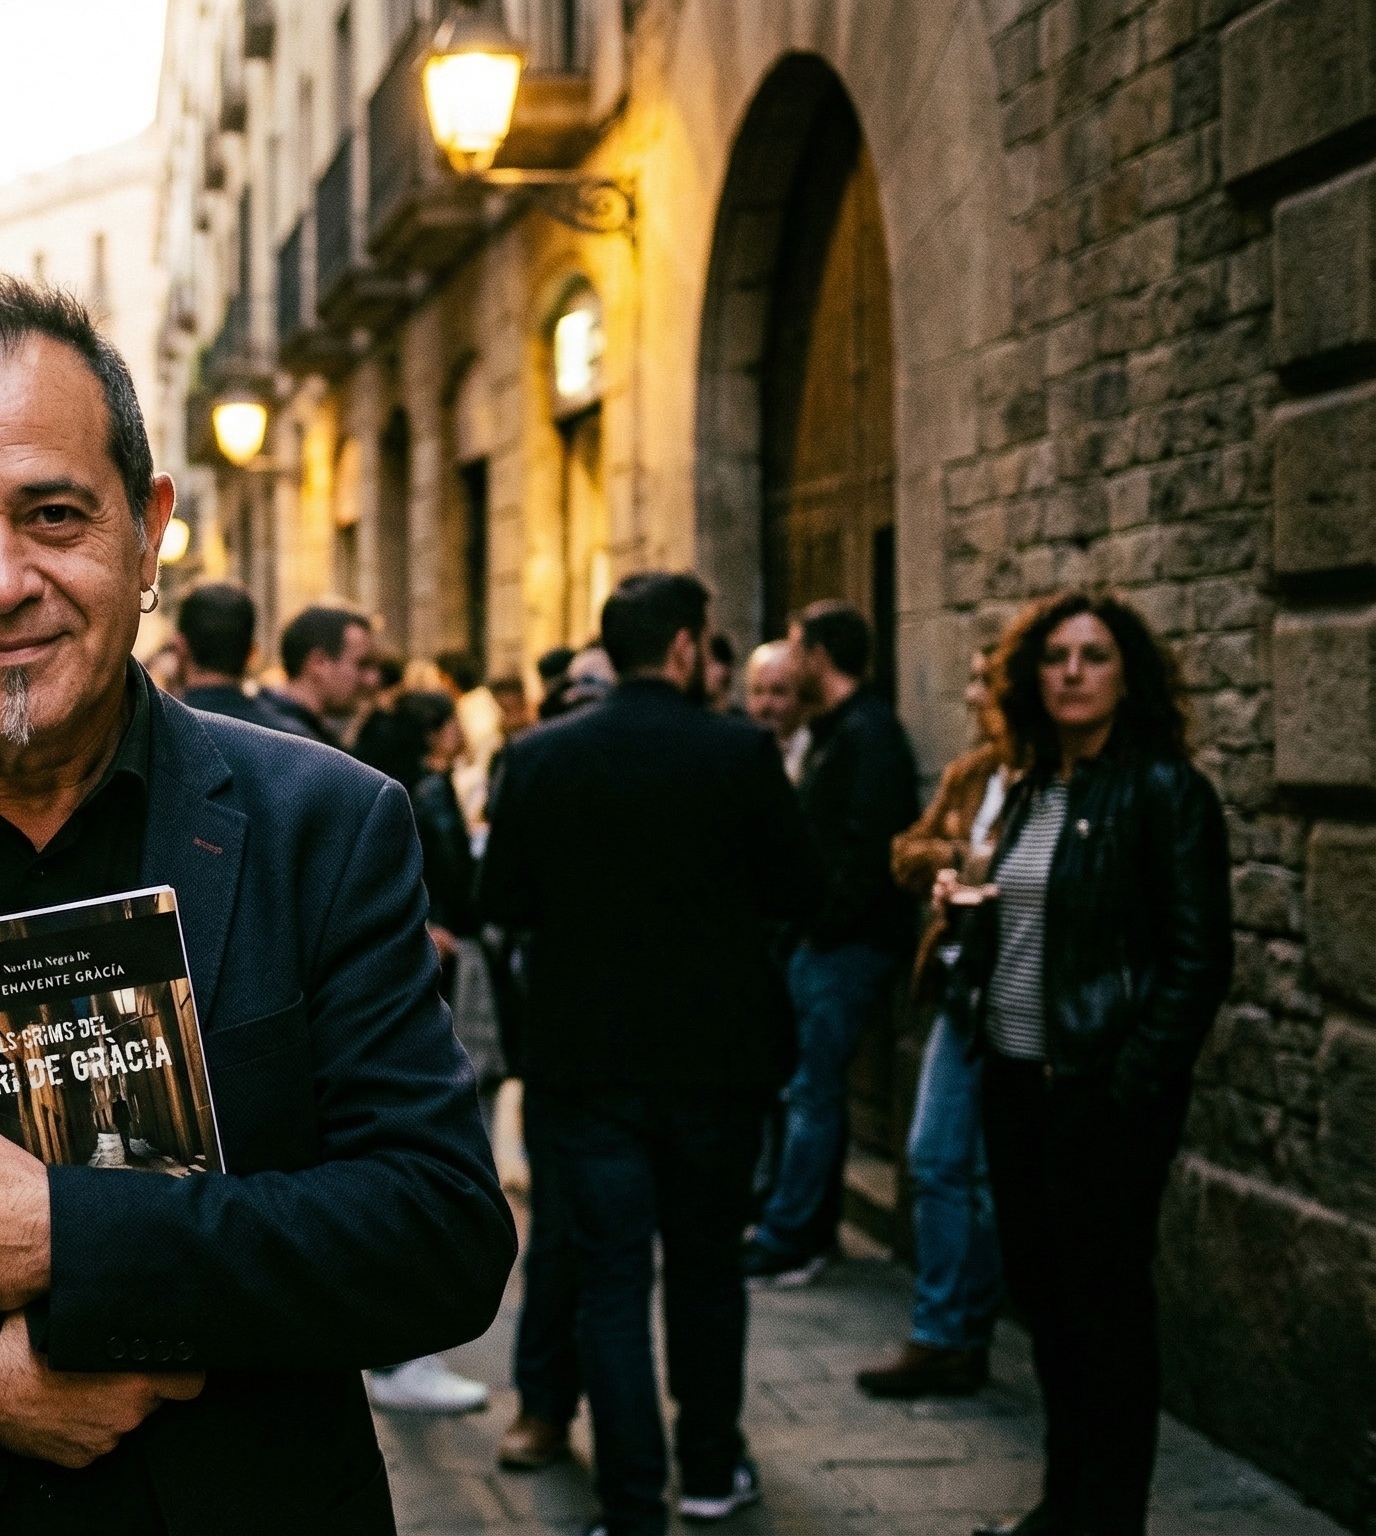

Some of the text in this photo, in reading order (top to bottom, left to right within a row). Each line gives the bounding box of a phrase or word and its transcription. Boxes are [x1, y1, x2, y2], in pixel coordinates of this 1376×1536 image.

[78, 1015, 112, 1038] DEL
[26, 1054, 63, 1090] DE
[70, 1036, 173, 1082] GRÀCIA
